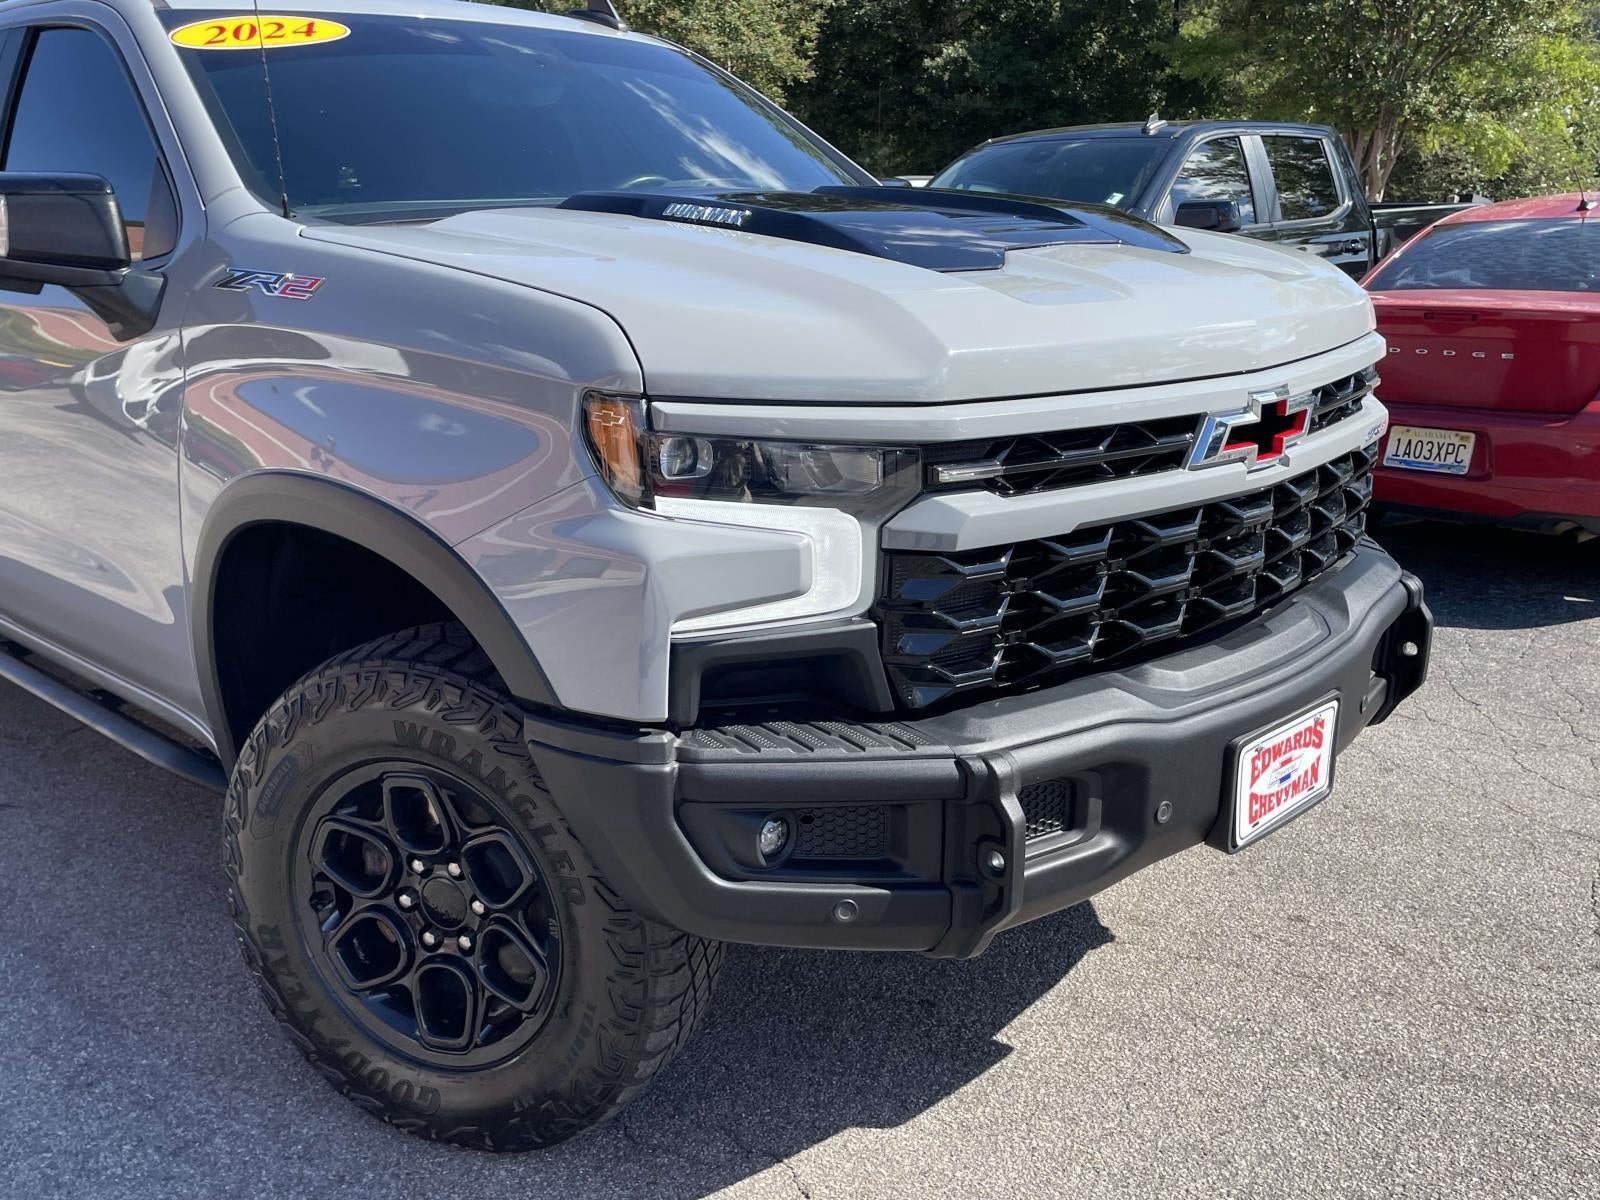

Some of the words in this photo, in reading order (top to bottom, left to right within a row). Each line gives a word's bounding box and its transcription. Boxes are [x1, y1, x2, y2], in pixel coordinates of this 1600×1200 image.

[203, 20, 317, 46] 2024
[662, 202, 752, 227] DURAMAX
[212, 267, 325, 300] ZR2
[1389, 346, 1515, 360] DODGE
[1412, 430, 1453, 441] ALABAMA
[1391, 437, 1467, 464] 1A03XPC
[1250, 718, 1325, 789] EDWARDS
[1248, 753, 1322, 825] CHEVYMAN
[393, 718, 586, 906] WRANGLER
